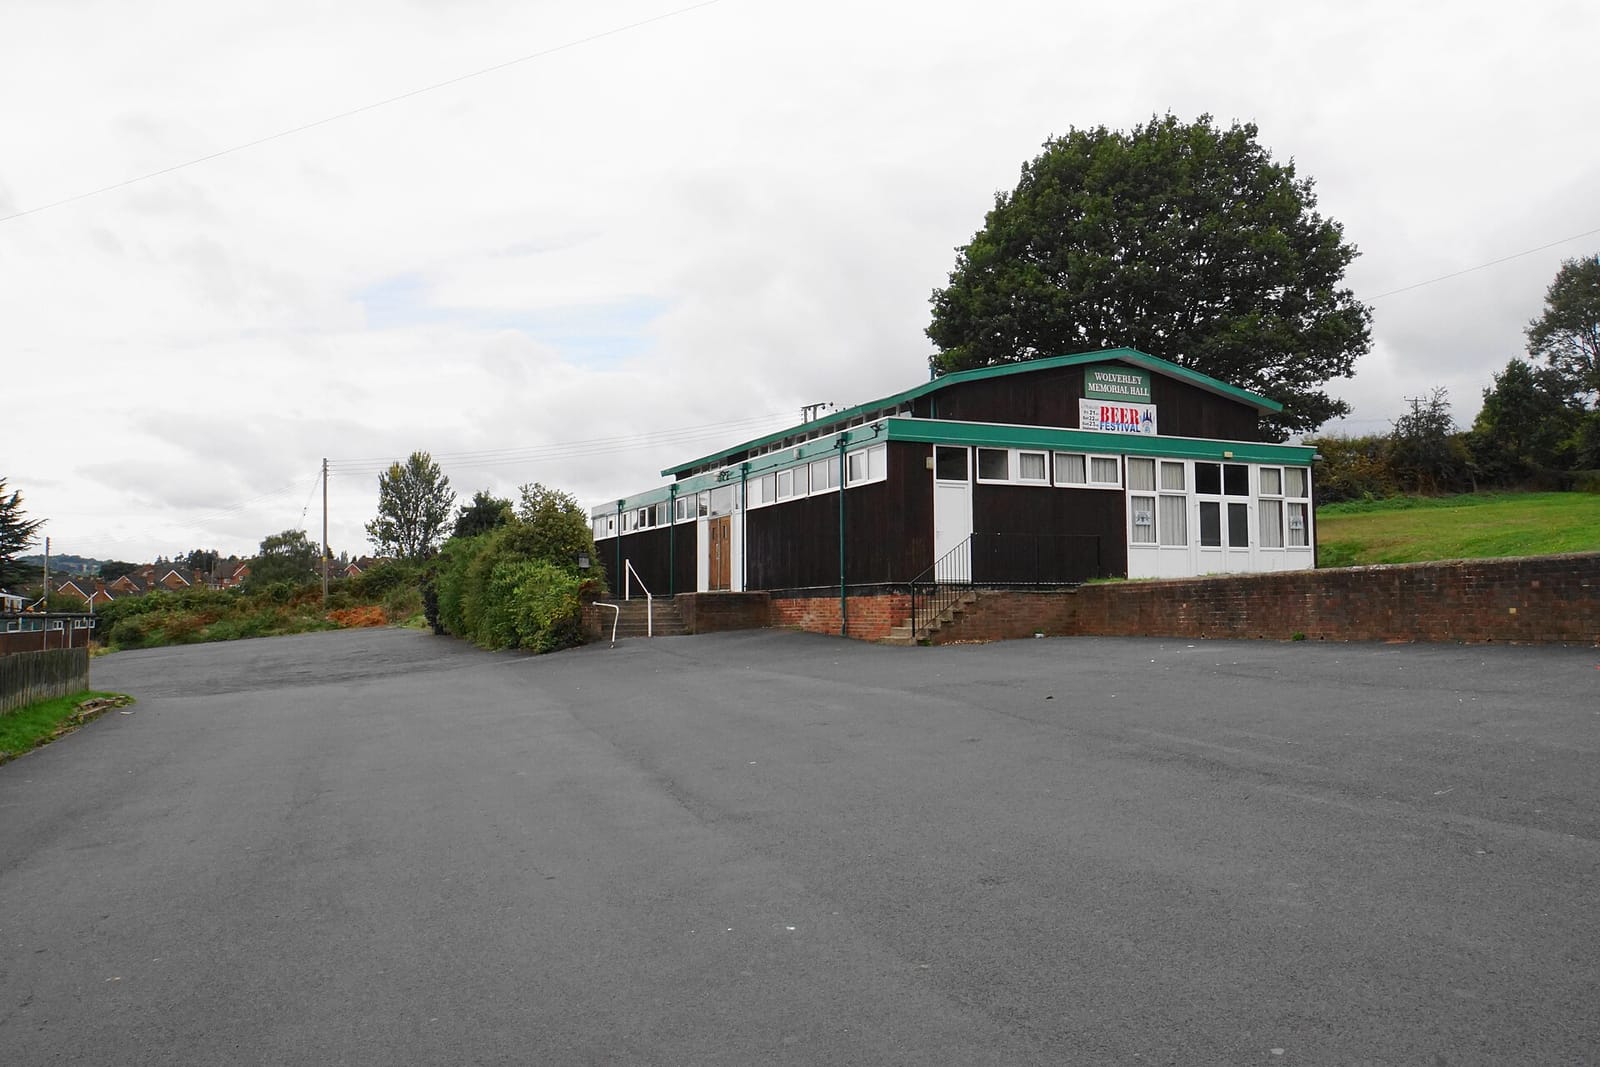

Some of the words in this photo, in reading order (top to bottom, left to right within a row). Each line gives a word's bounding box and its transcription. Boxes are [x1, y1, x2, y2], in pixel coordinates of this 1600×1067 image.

[1094, 372, 1142, 385] WOLVERLEY
[1088, 383, 1129, 395] MEMORIAL
[1130, 387, 1150, 396] HALL
[1100, 406, 1140, 425] BEER
[1100, 422, 1141, 433] FESTIVAL
